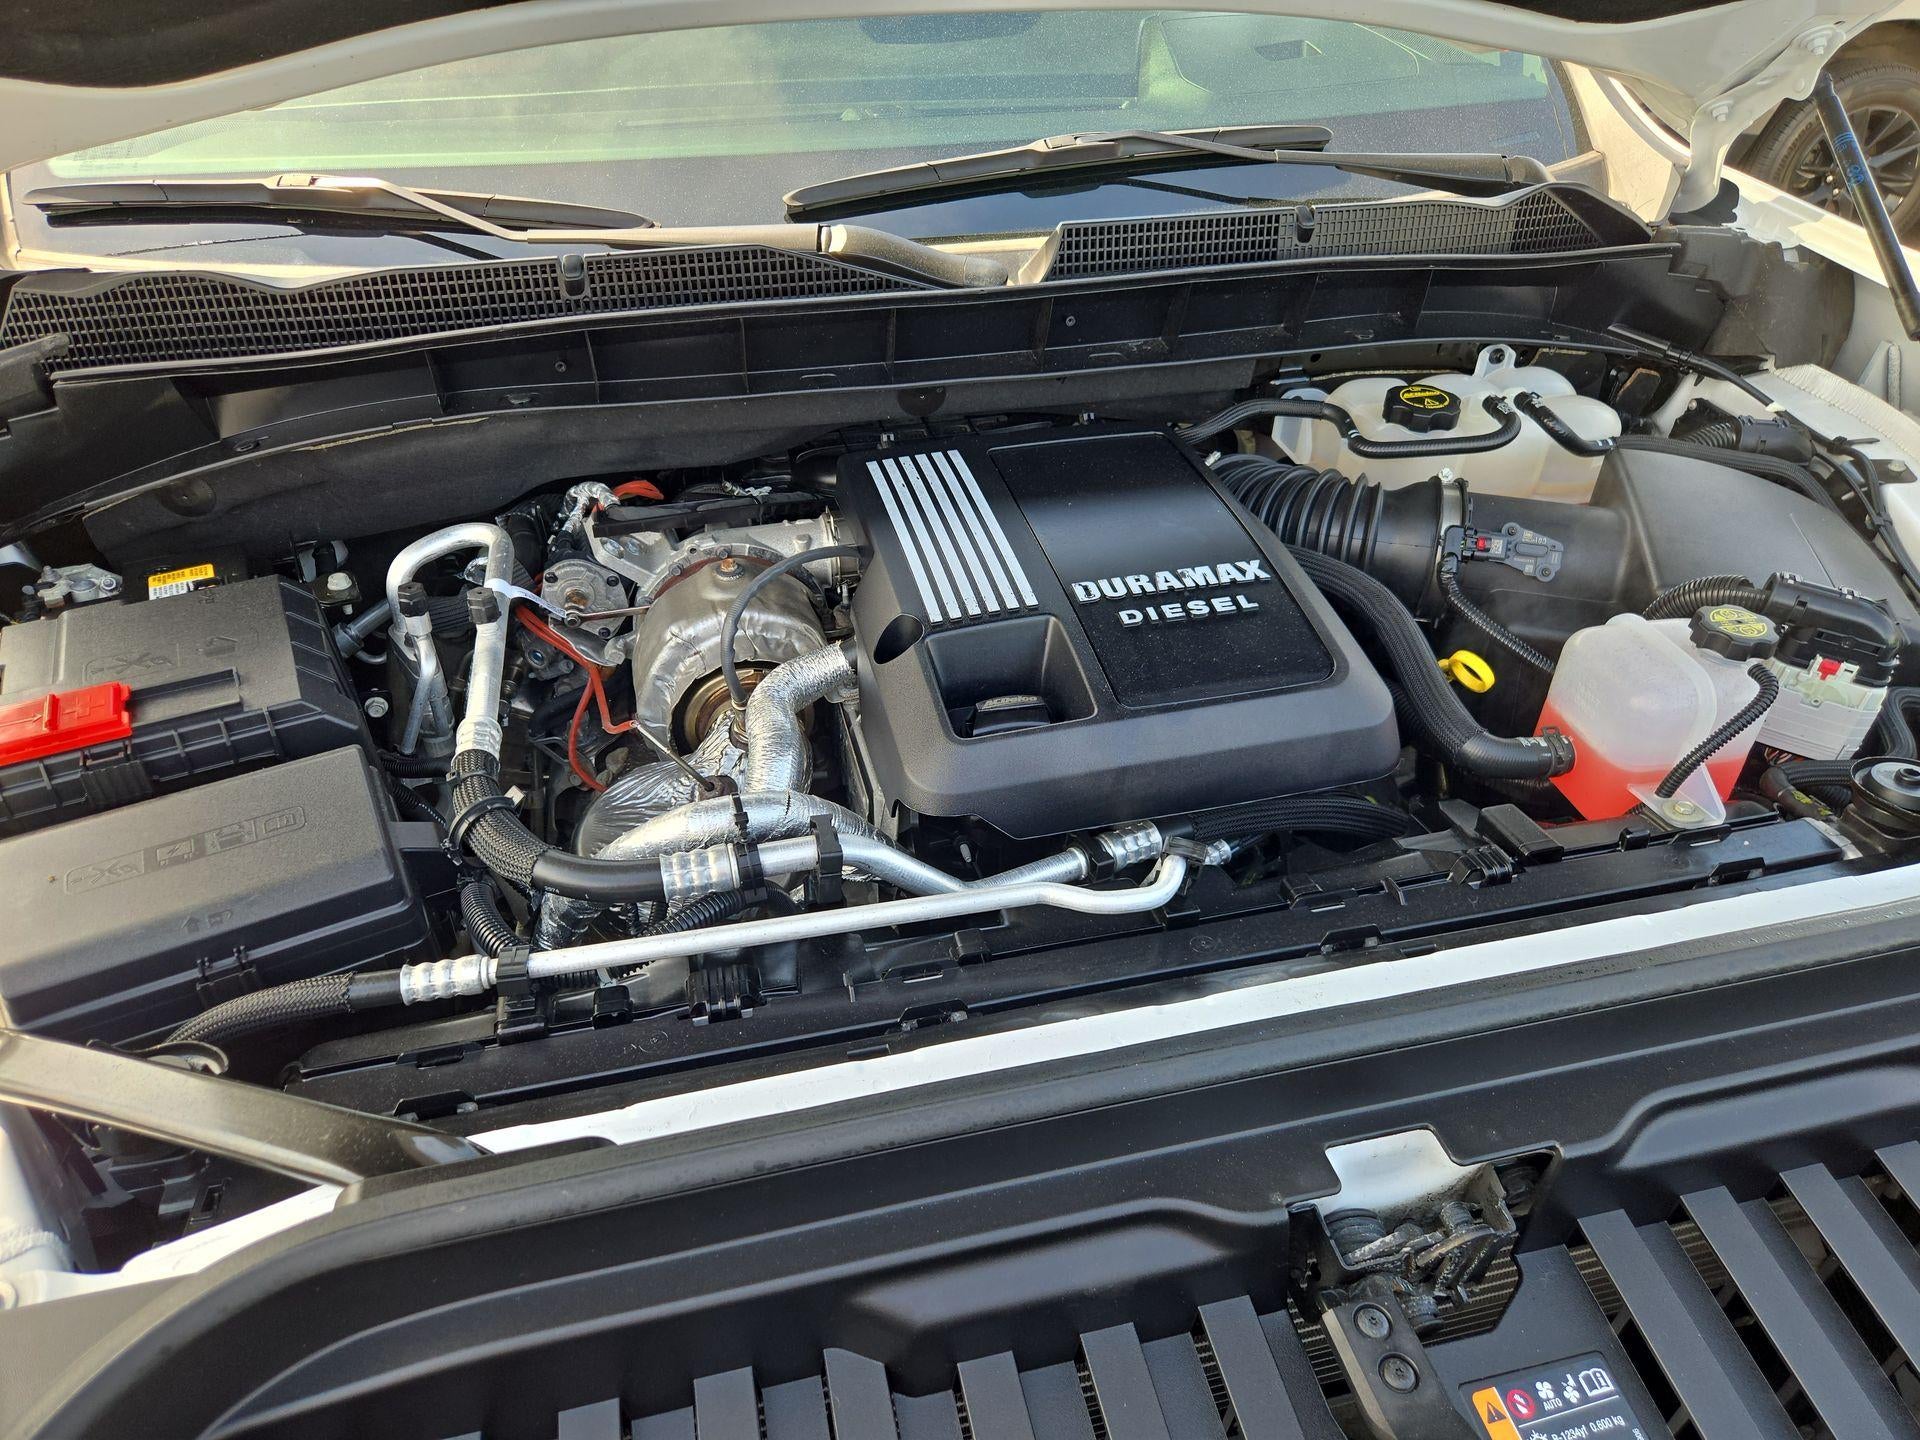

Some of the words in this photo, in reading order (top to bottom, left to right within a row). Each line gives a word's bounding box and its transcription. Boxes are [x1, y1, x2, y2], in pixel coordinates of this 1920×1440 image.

[1072, 559, 1271, 604] DURAMAX
[1118, 594, 1260, 628] DIESEL
[1543, 1397, 1562, 1411] AUTO
[1589, 1416, 1613, 1432] 0.600
[1610, 1415, 1626, 1427] kg
